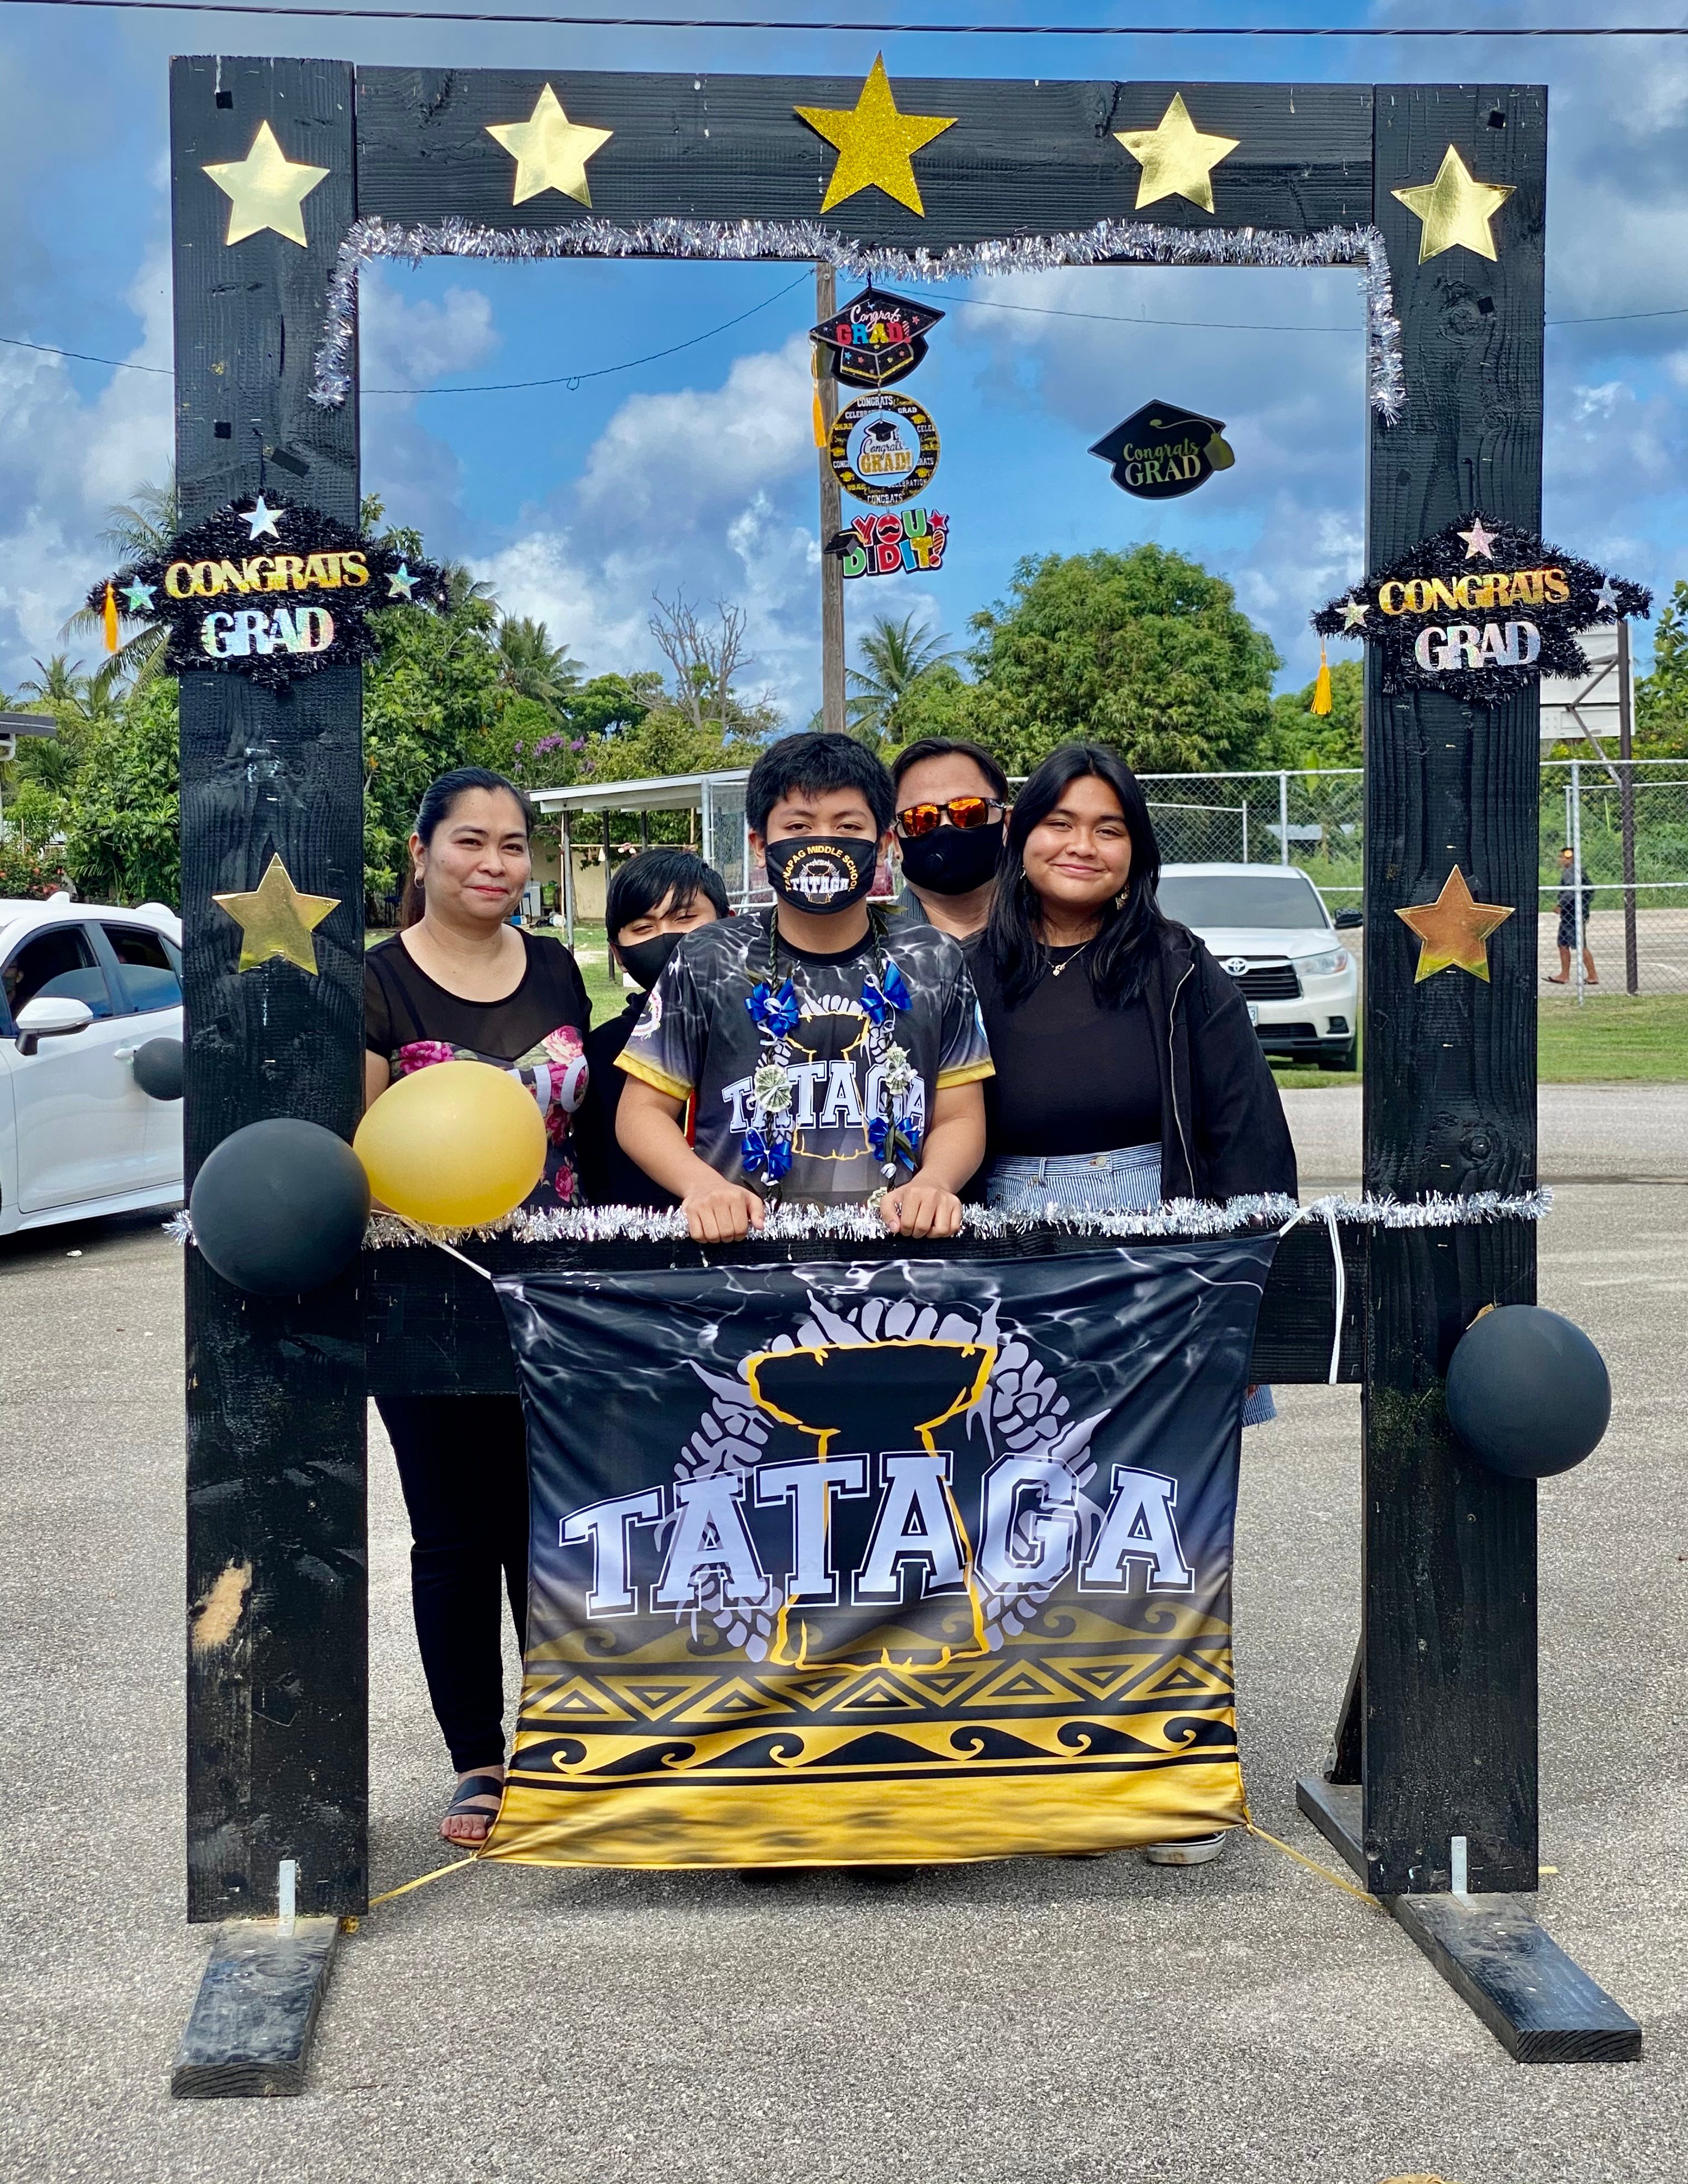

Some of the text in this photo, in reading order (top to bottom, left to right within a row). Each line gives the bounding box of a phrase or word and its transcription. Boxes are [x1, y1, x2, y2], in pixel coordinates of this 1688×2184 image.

[836, 320, 912, 344] GRAD!
[850, 304, 901, 332] Congrats
[857, 395, 893, 408] CONGRATS
[917, 424, 935, 433] CELE
[861, 451, 911, 473] GRAD!
[864, 439, 902, 459] Congrats
[1124, 438, 1200, 463] Congrats
[1125, 454, 1201, 486] GRAD
[867, 494, 903, 504] CONGRATS
[852, 507, 927, 547] YOU
[843, 530, 945, 576] DID IT!
[165, 550, 370, 599] CONGRATS
[1378, 568, 1570, 615] CONGRATS
[200, 607, 335, 658] GRAD
[1414, 620, 1541, 672] GRAD
[783, 845, 859, 892] TANAPAG MIDDLE SCHOOL
[790, 876, 850, 893] TATAGA
[559, 1450, 1195, 1619] TATAGA
